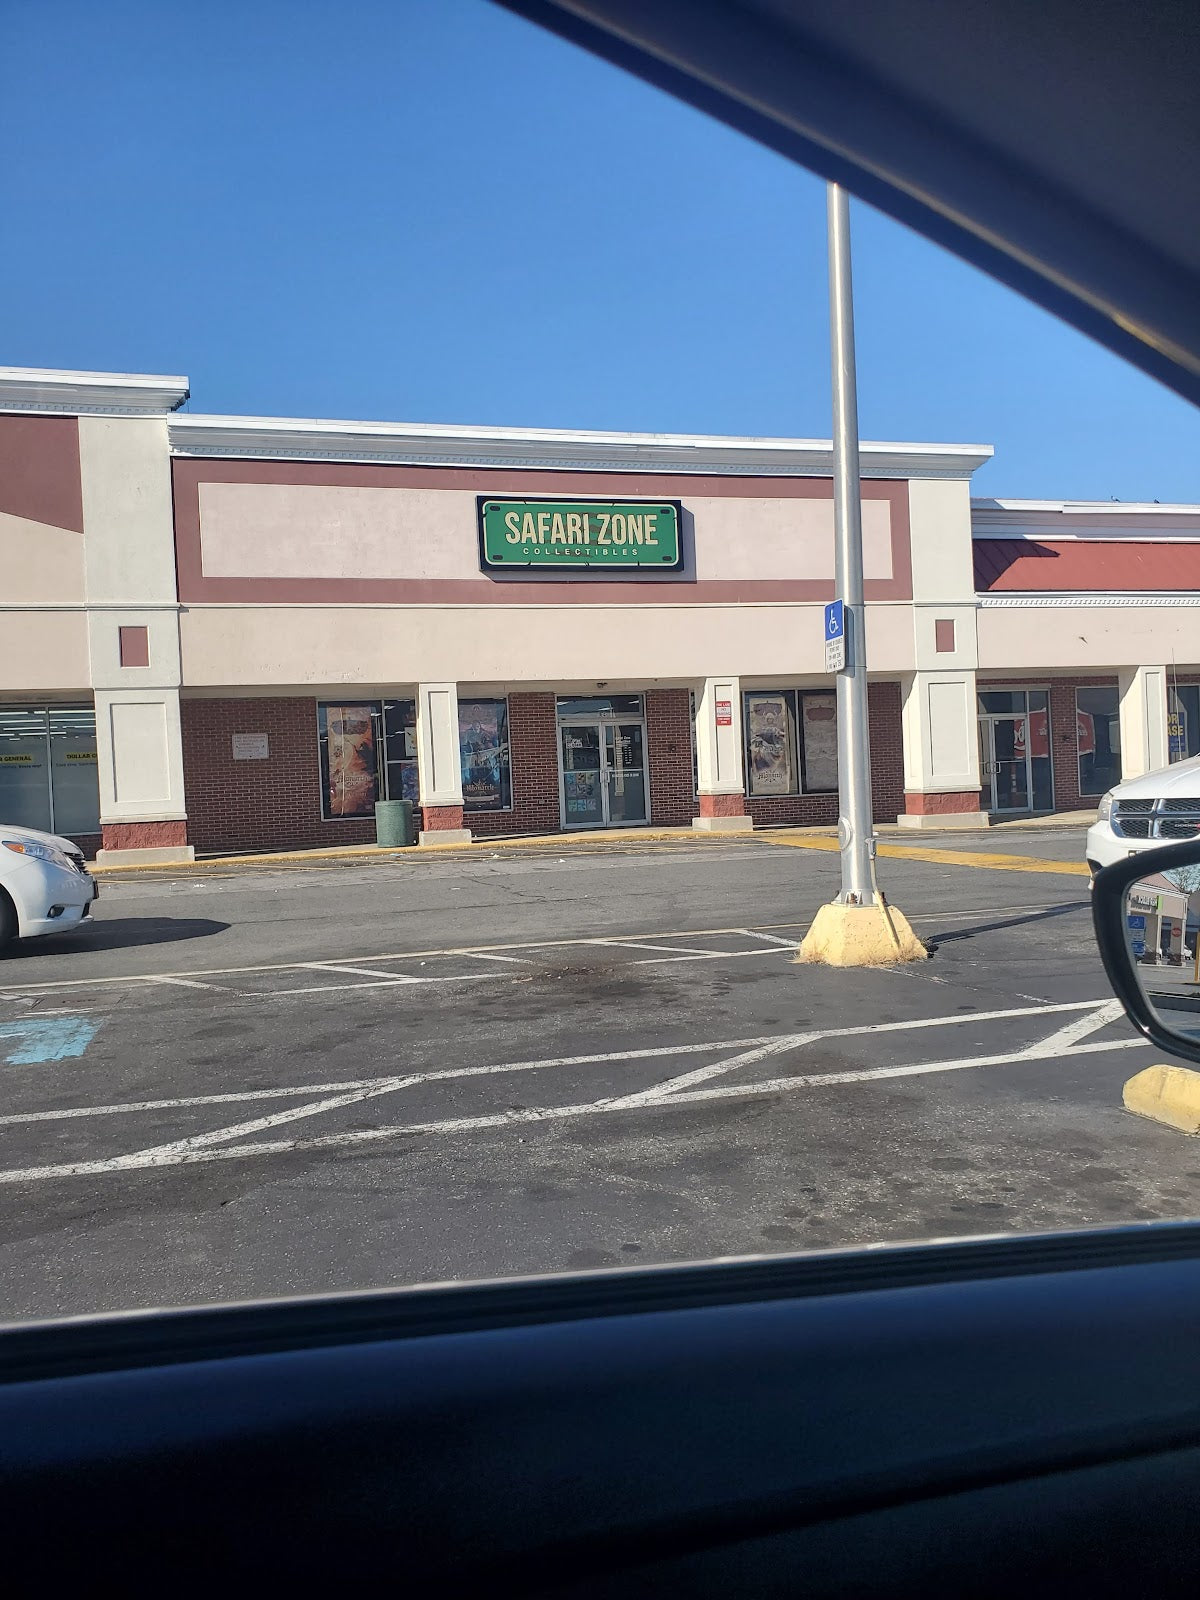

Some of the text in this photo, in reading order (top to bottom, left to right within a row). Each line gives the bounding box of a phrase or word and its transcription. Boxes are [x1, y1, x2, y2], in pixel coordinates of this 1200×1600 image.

[504, 511, 659, 545] SAFARI ZONE
[522, 547, 638, 556] COLLECTIBLES
